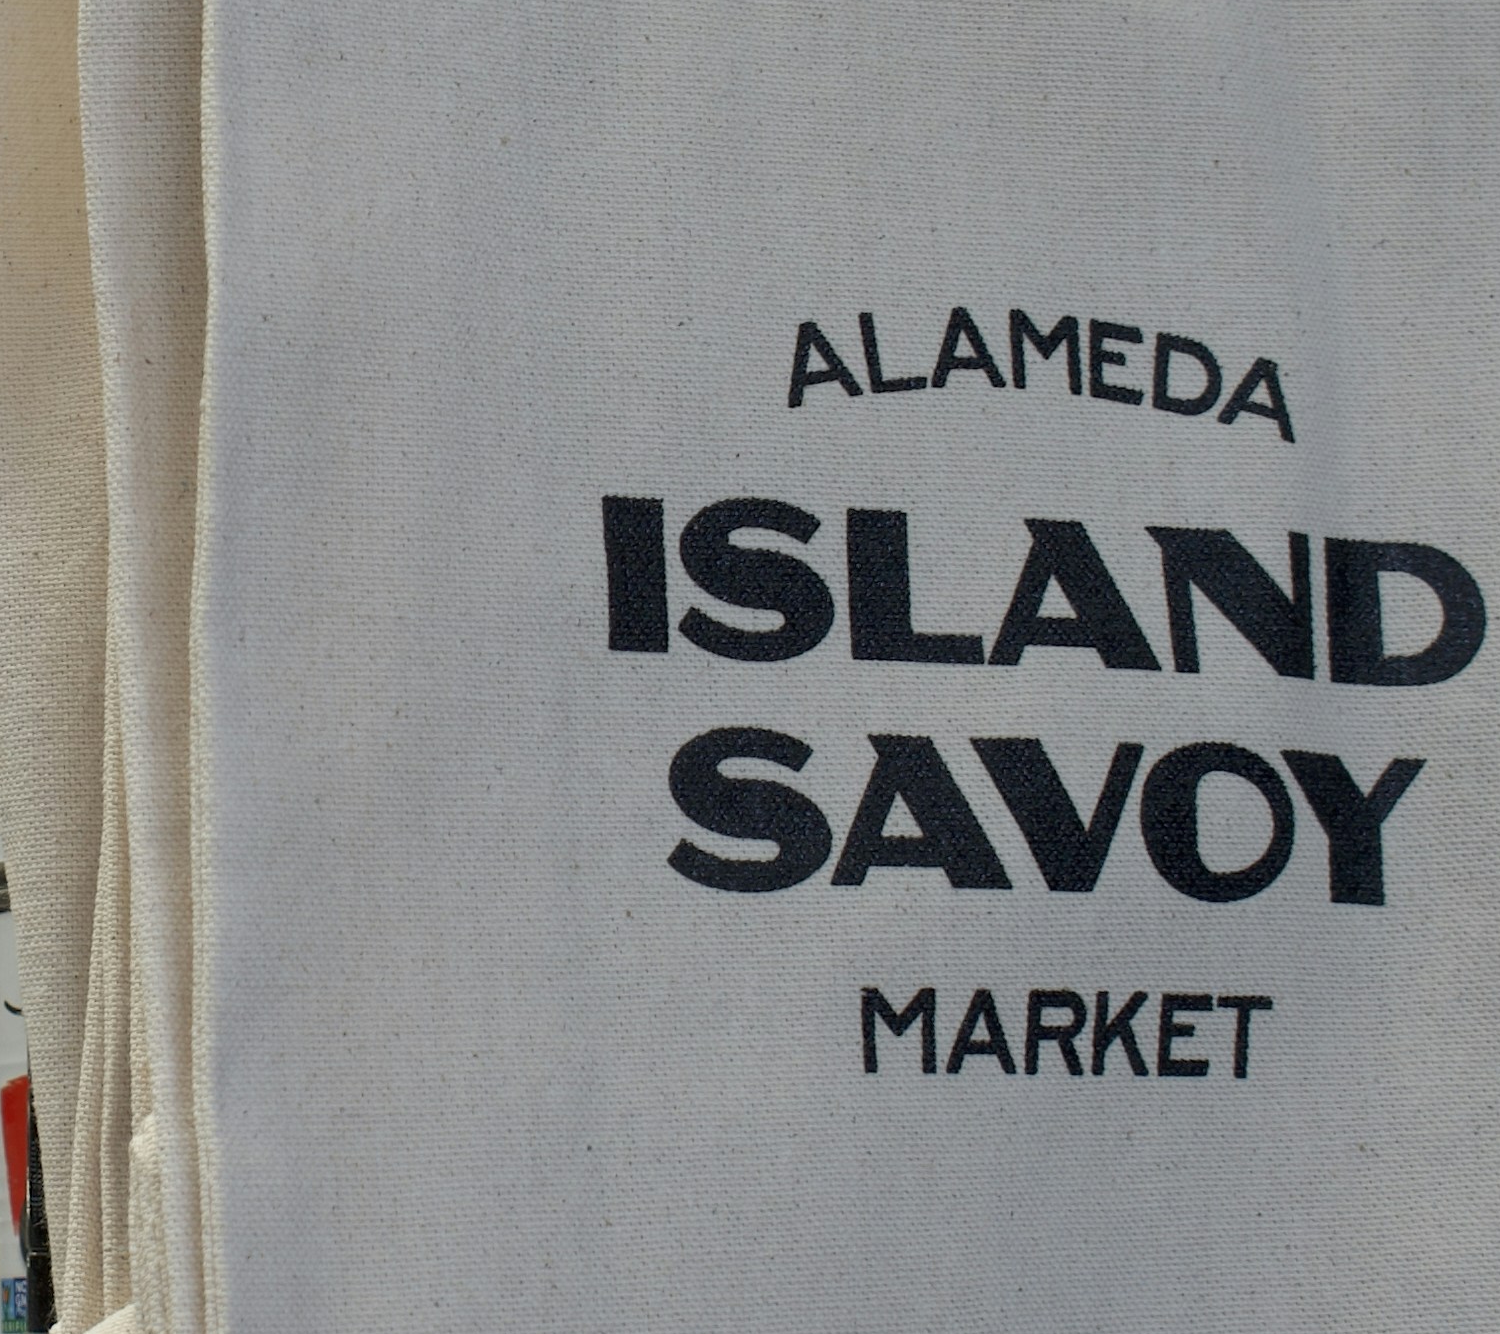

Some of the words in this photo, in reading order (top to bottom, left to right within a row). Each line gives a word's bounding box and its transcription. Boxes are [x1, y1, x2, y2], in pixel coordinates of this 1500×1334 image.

[787, 306, 1296, 444] ALAMEDA
[601, 494, 1487, 687] ISLAND
[666, 725, 1427, 906] SAVOY
[859, 985, 1273, 1079] MARKET
